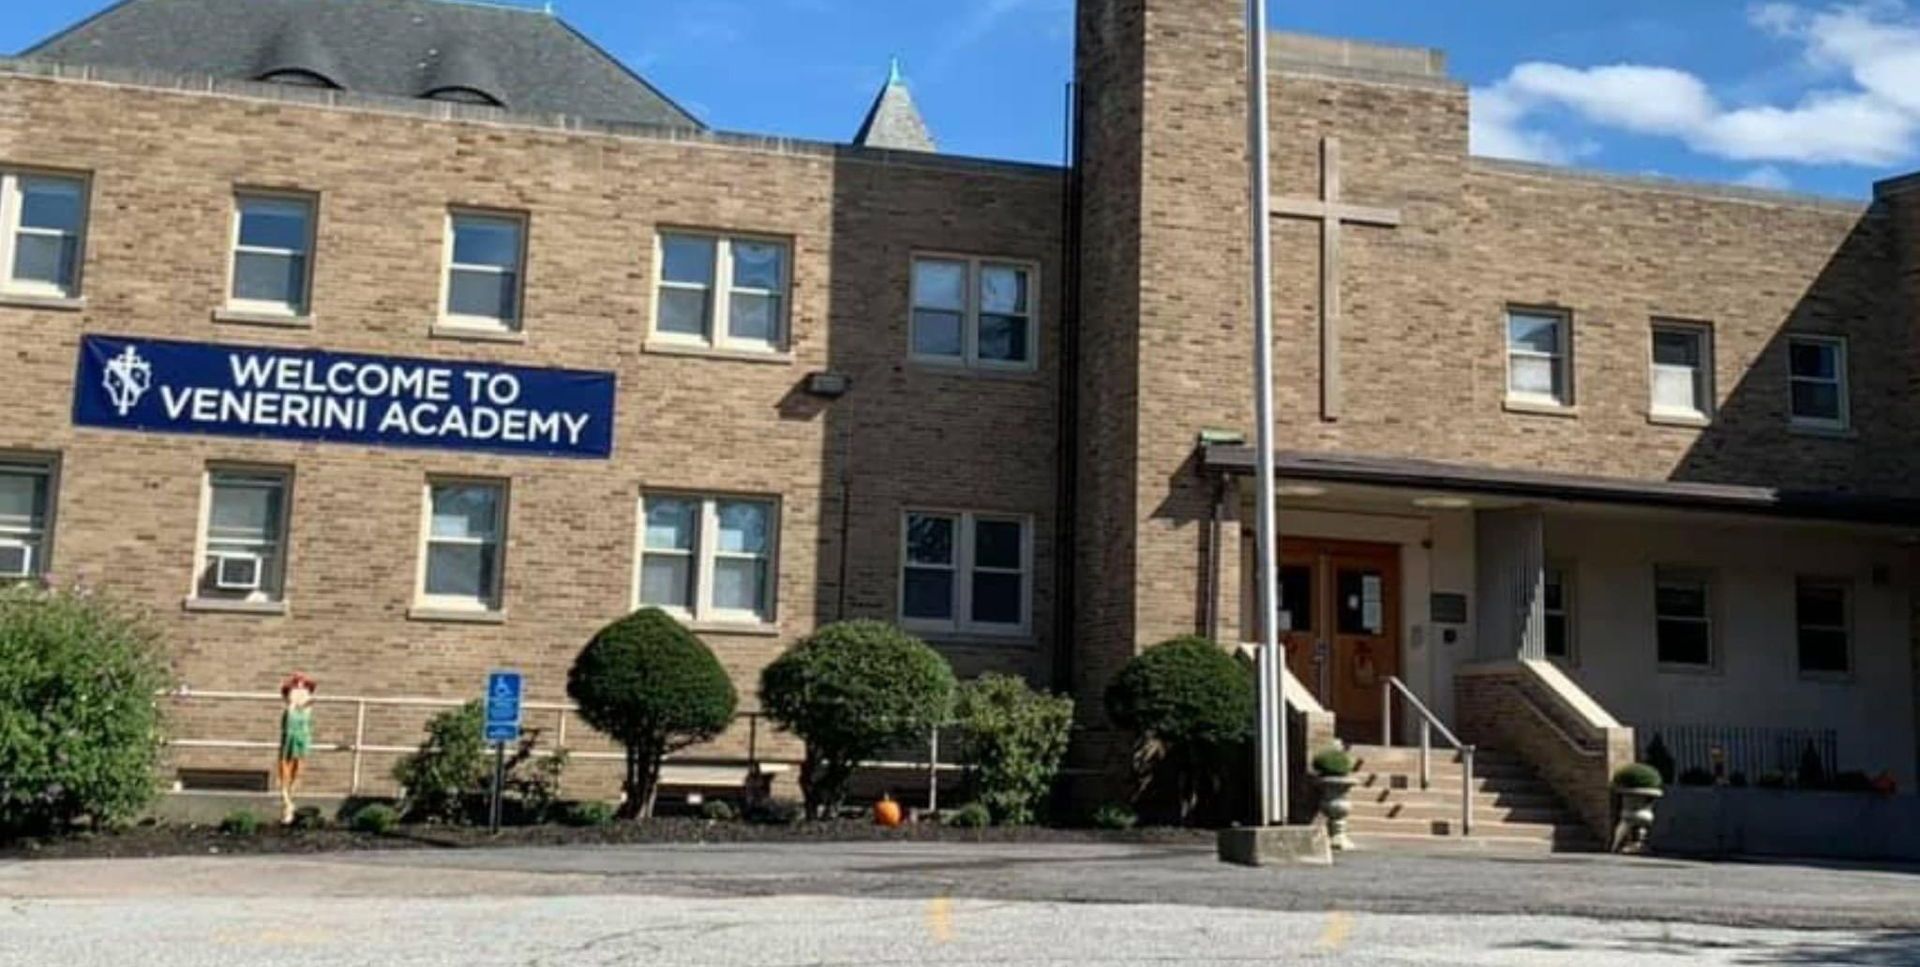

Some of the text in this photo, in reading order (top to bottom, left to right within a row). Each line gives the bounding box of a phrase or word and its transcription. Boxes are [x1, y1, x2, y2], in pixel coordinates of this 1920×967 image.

[229, 354, 520, 405] WELCOME TO
[161, 385, 589, 444] VENERINI ACADEMY
